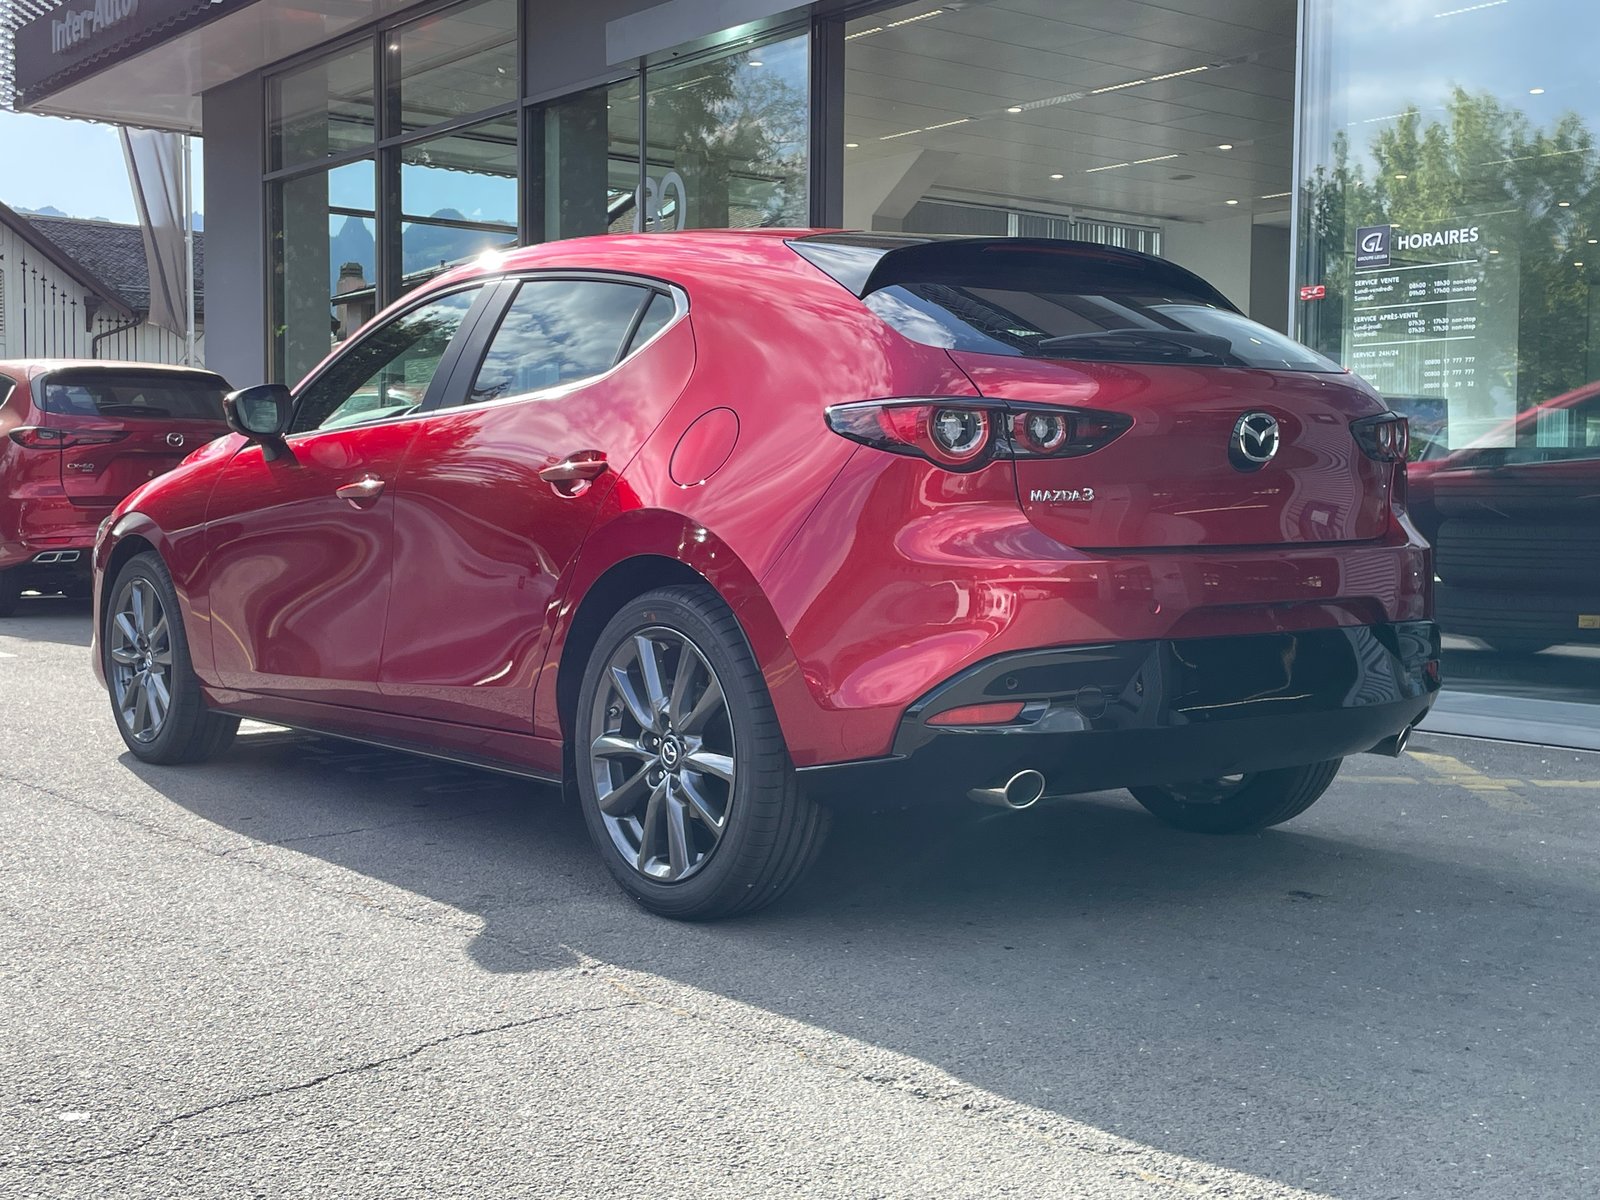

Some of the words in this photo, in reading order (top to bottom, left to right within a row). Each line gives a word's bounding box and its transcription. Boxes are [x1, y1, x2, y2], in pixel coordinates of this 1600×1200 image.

[1361, 232, 1384, 253] GL
[1397, 226, 1479, 250] HORAIRES
[1354, 279, 1378, 287] SERVICE
[1380, 276, 1400, 284] VENTE
[1353, 315, 1377, 323] SERVICE
[1379, 311, 1419, 321] APRÈS-VENTE
[1433, 317, 1450, 325] 17h30
[1433, 324, 1450, 332] 17h30
[1352, 351, 1376, 359] SERVICE
[1378, 349, 1399, 357] 24H/24
[1030, 487, 1095, 502] MAZDA3
